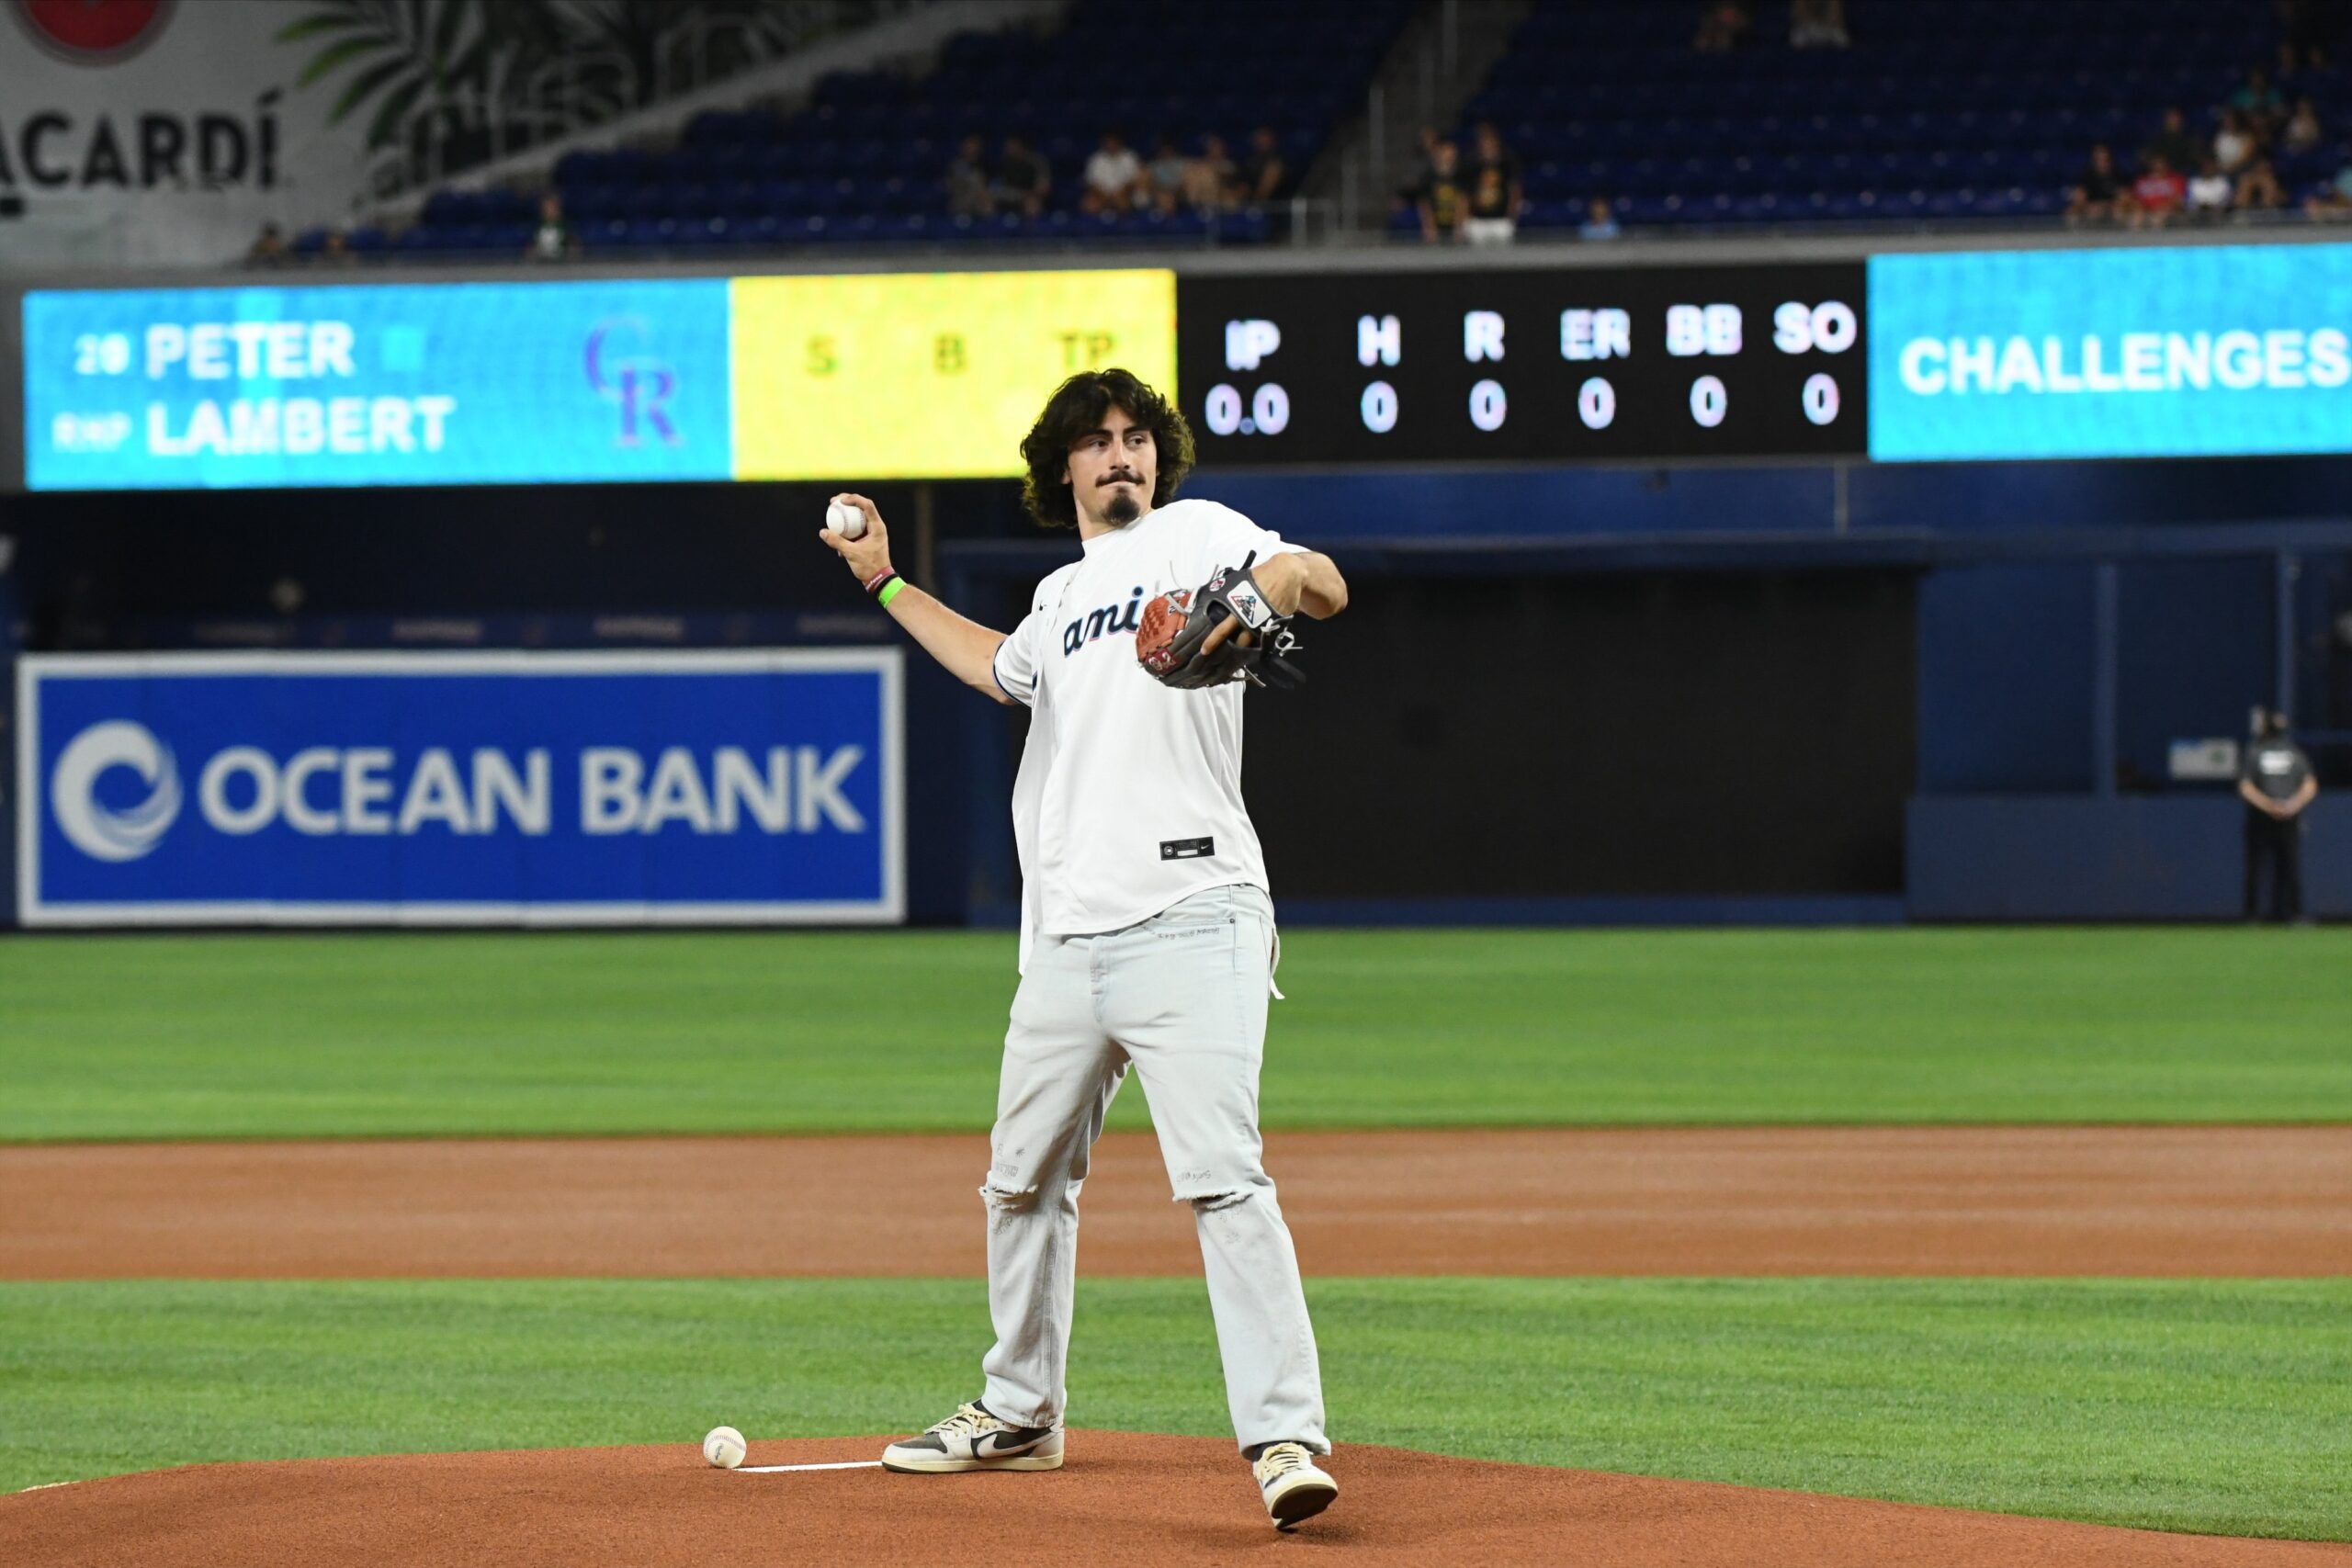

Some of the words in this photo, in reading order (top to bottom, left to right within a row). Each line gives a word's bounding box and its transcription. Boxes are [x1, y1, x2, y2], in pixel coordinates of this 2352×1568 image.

[145, 321, 356, 379] PETER
[807, 334, 838, 374] S
[934, 333, 965, 374] B
[1059, 331, 1114, 369] TP
[1225, 320, 1281, 370] IP
[1358, 314, 1401, 367] H
[1464, 310, 1505, 362] R
[1560, 308, 1631, 360] ER
[1666, 304, 1742, 356] BB
[1773, 300, 1857, 354] SO
[1898, 327, 2350, 396] CHALLENGES
[145, 396, 458, 456] LAMBERT
[1205, 382, 1290, 435] 0.0
[1361, 380, 1398, 434] 0
[1469, 378, 1508, 432] 0
[1578, 377, 1616, 429] 0
[1690, 375, 1727, 427] 0
[1802, 372, 1840, 425] 0
[1064, 585, 1143, 659] ami
[198, 745, 551, 836] OCEAN
[580, 744, 866, 835] BANK
